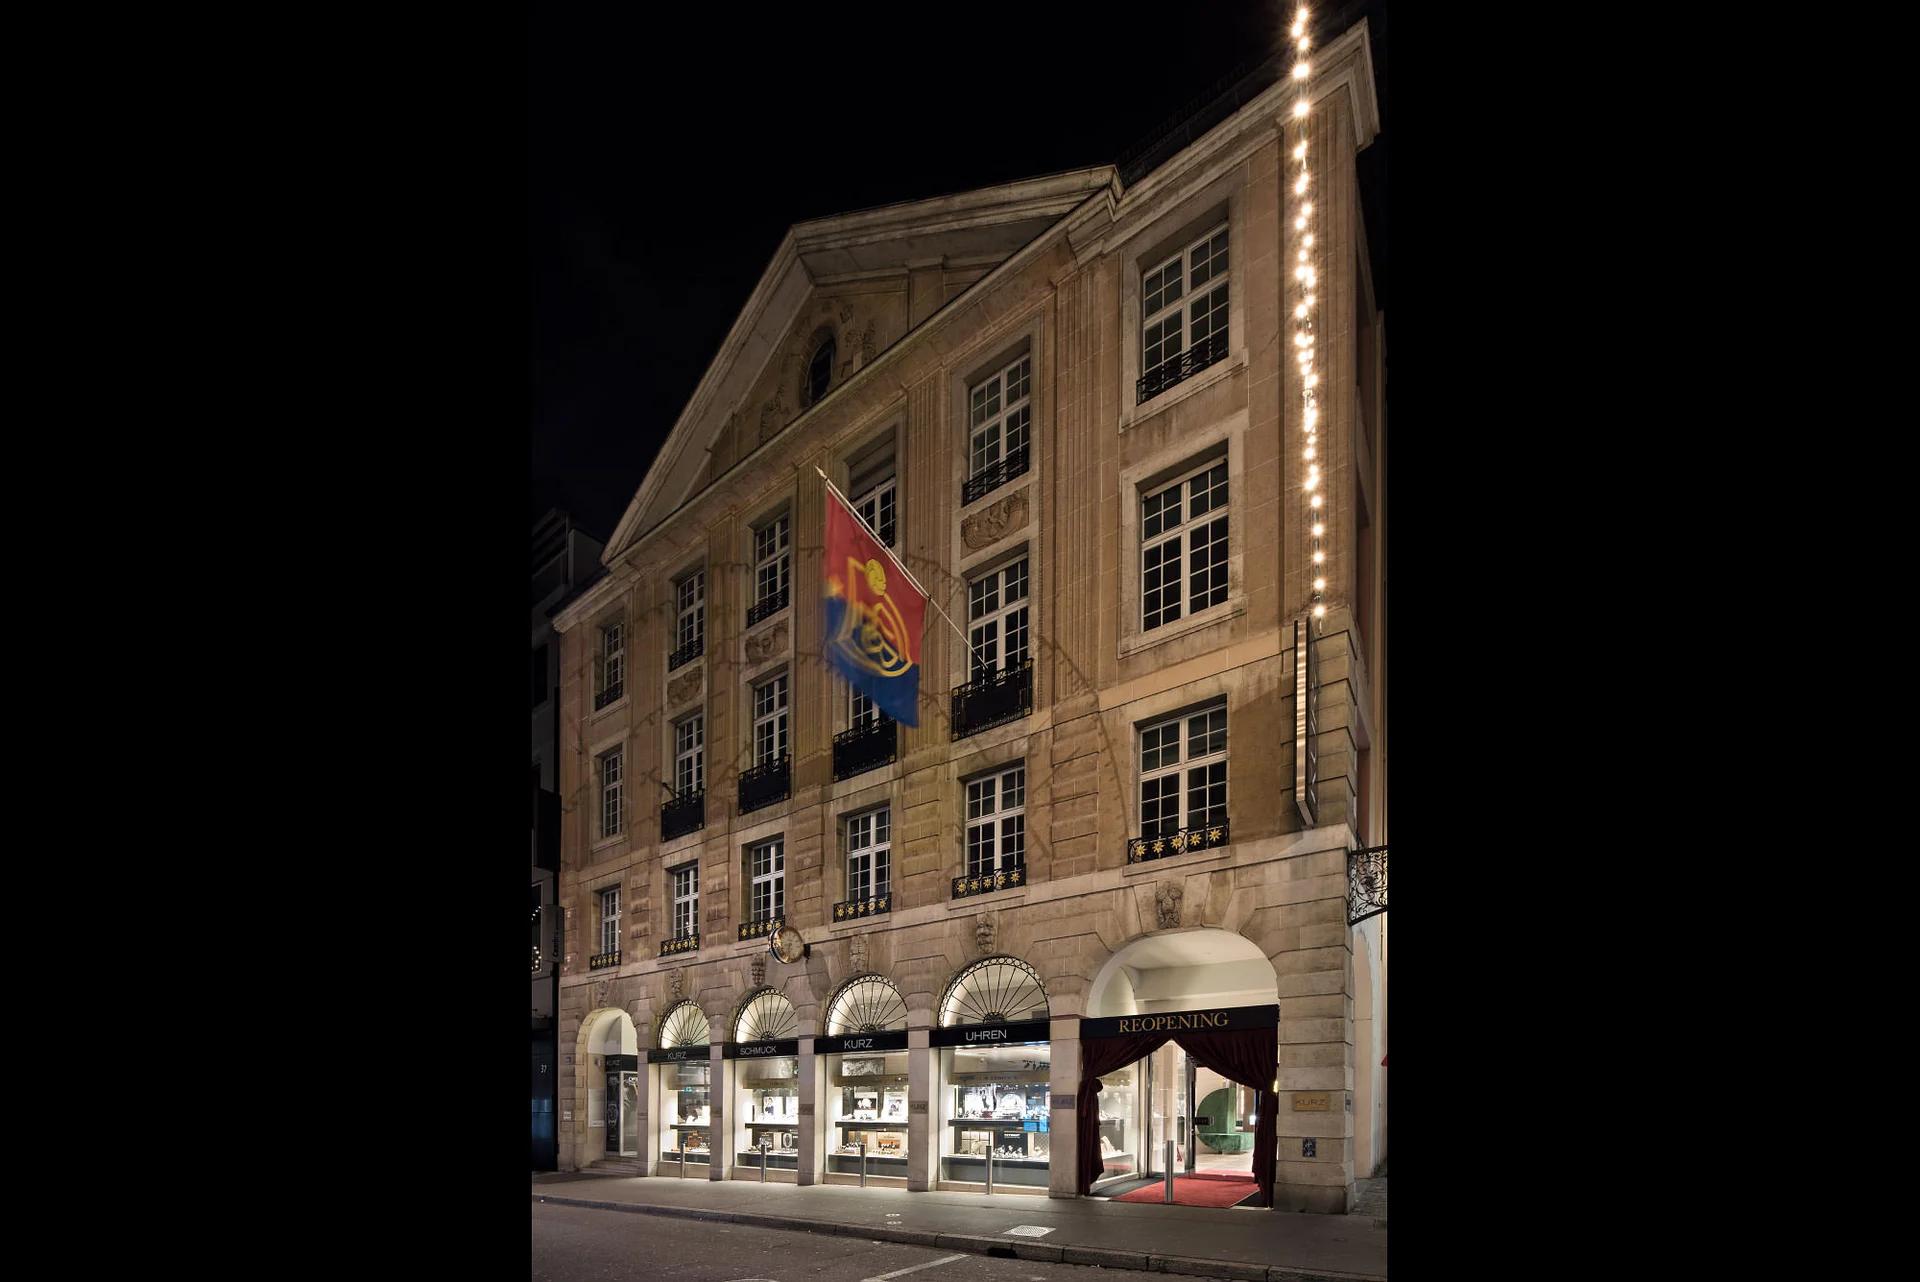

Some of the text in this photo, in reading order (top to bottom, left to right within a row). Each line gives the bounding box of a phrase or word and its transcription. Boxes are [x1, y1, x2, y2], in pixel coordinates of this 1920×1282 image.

[1118, 1011, 1230, 1033] REOPENING
[965, 1029, 1008, 1042] UHREN
[843, 1038, 874, 1049] KURZ
[667, 1051, 687, 1060] KURZ
[739, 1045, 777, 1056] SCHMUCK
[540, 1064, 547, 1074] 37
[1296, 1098, 1325, 1107] KURZ
